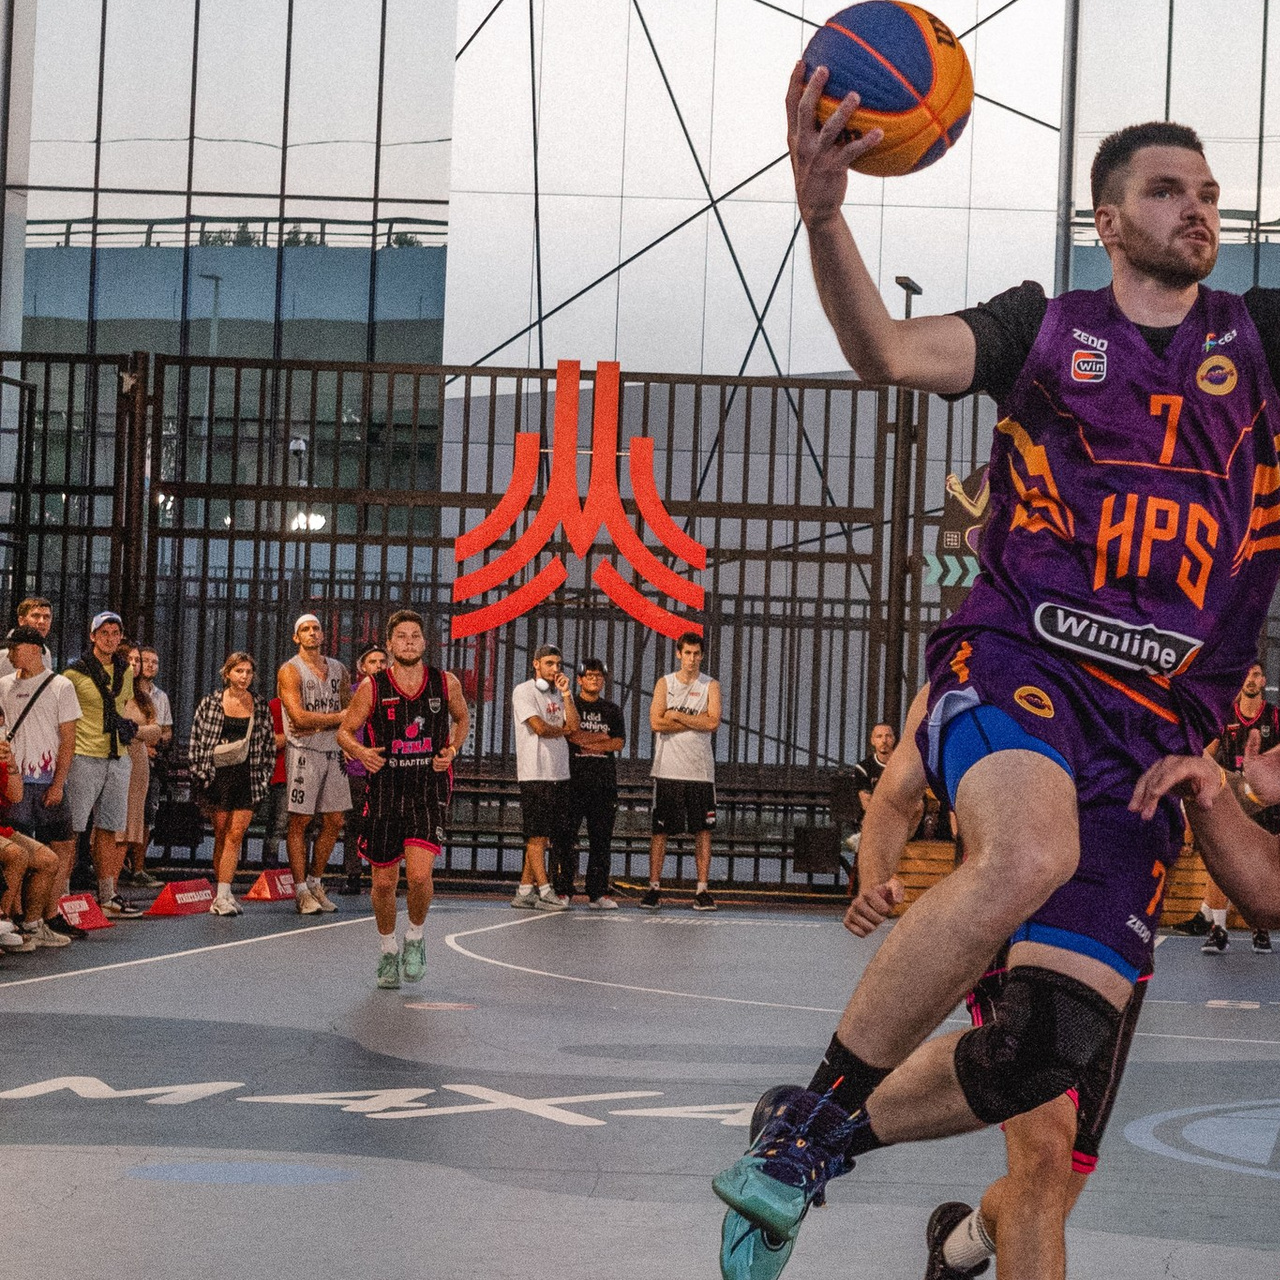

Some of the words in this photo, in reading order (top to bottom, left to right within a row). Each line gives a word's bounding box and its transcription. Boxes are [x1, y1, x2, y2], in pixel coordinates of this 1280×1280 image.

[1149, 394, 1183, 464] 7
[1093, 493, 1220, 611] HPS
[1056, 608, 1178, 669] Winline
[580, 721, 611, 734] othing.
[588, 712, 602, 722] did
[290, 788, 306, 805] 93
